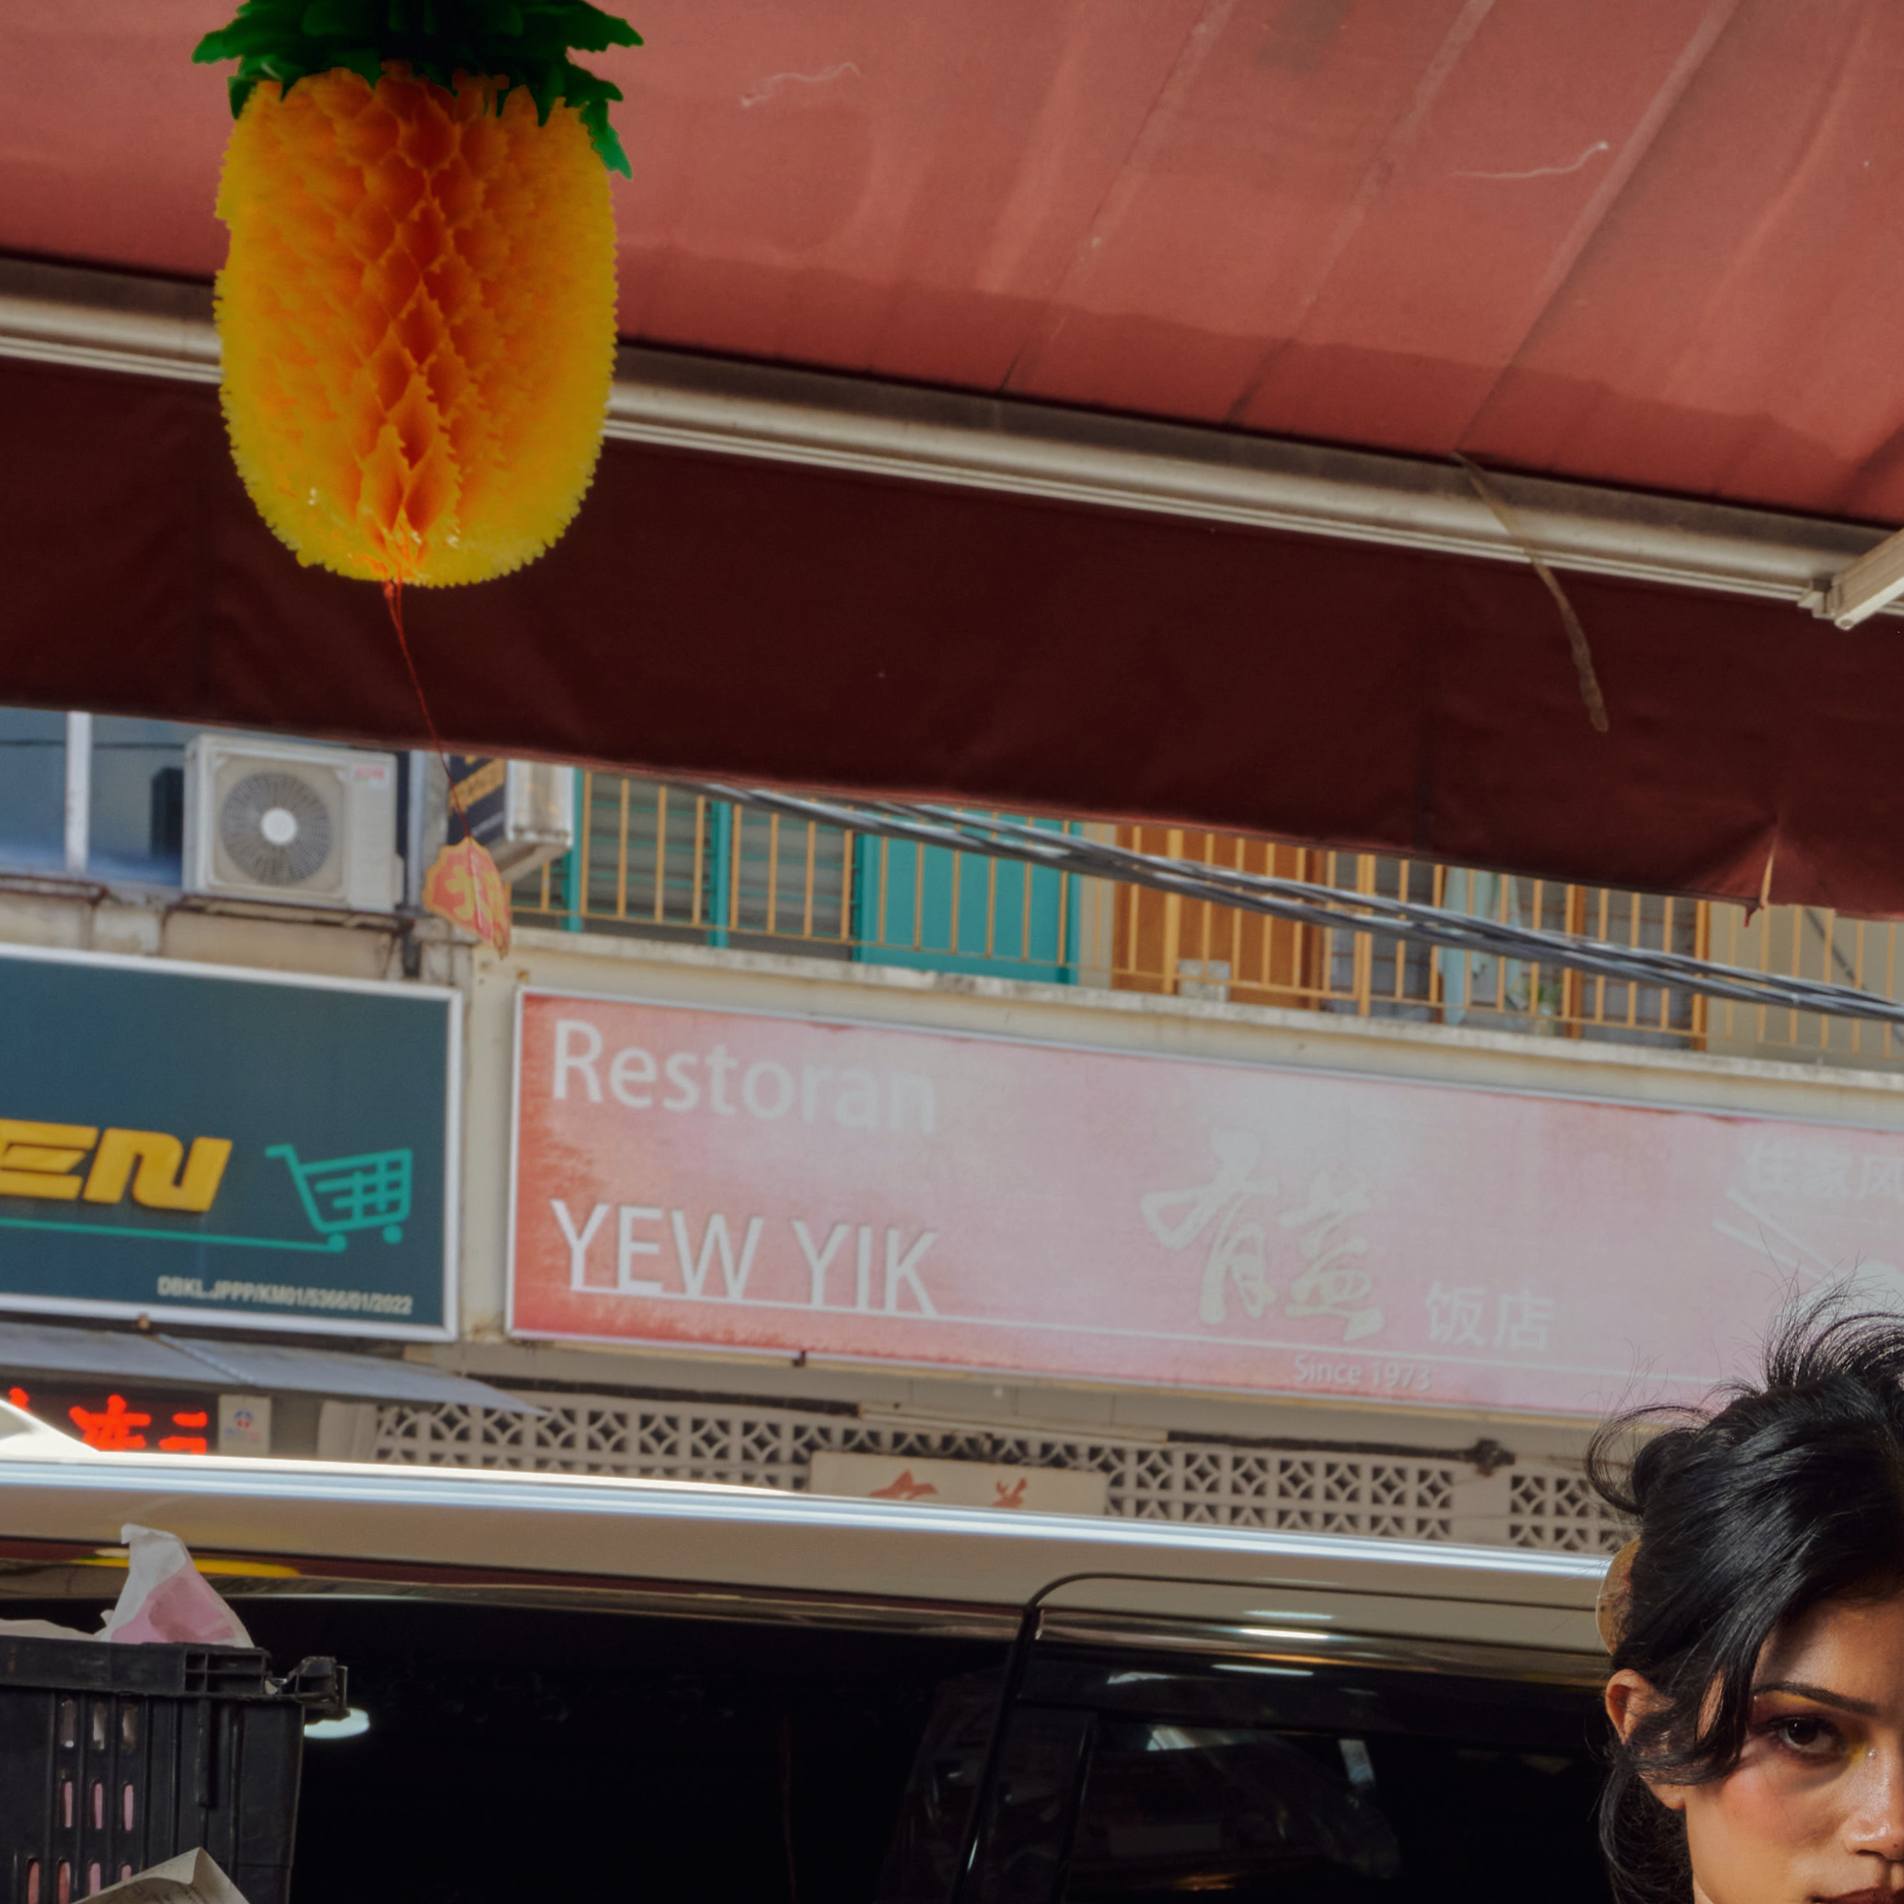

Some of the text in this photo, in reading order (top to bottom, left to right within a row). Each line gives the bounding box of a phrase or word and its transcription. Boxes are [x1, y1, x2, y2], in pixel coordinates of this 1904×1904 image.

[552, 1018, 936, 1135] Restoran
[550, 1198, 941, 1317] YEW YIK
[1292, 1353, 1432, 1393] Since 1973
